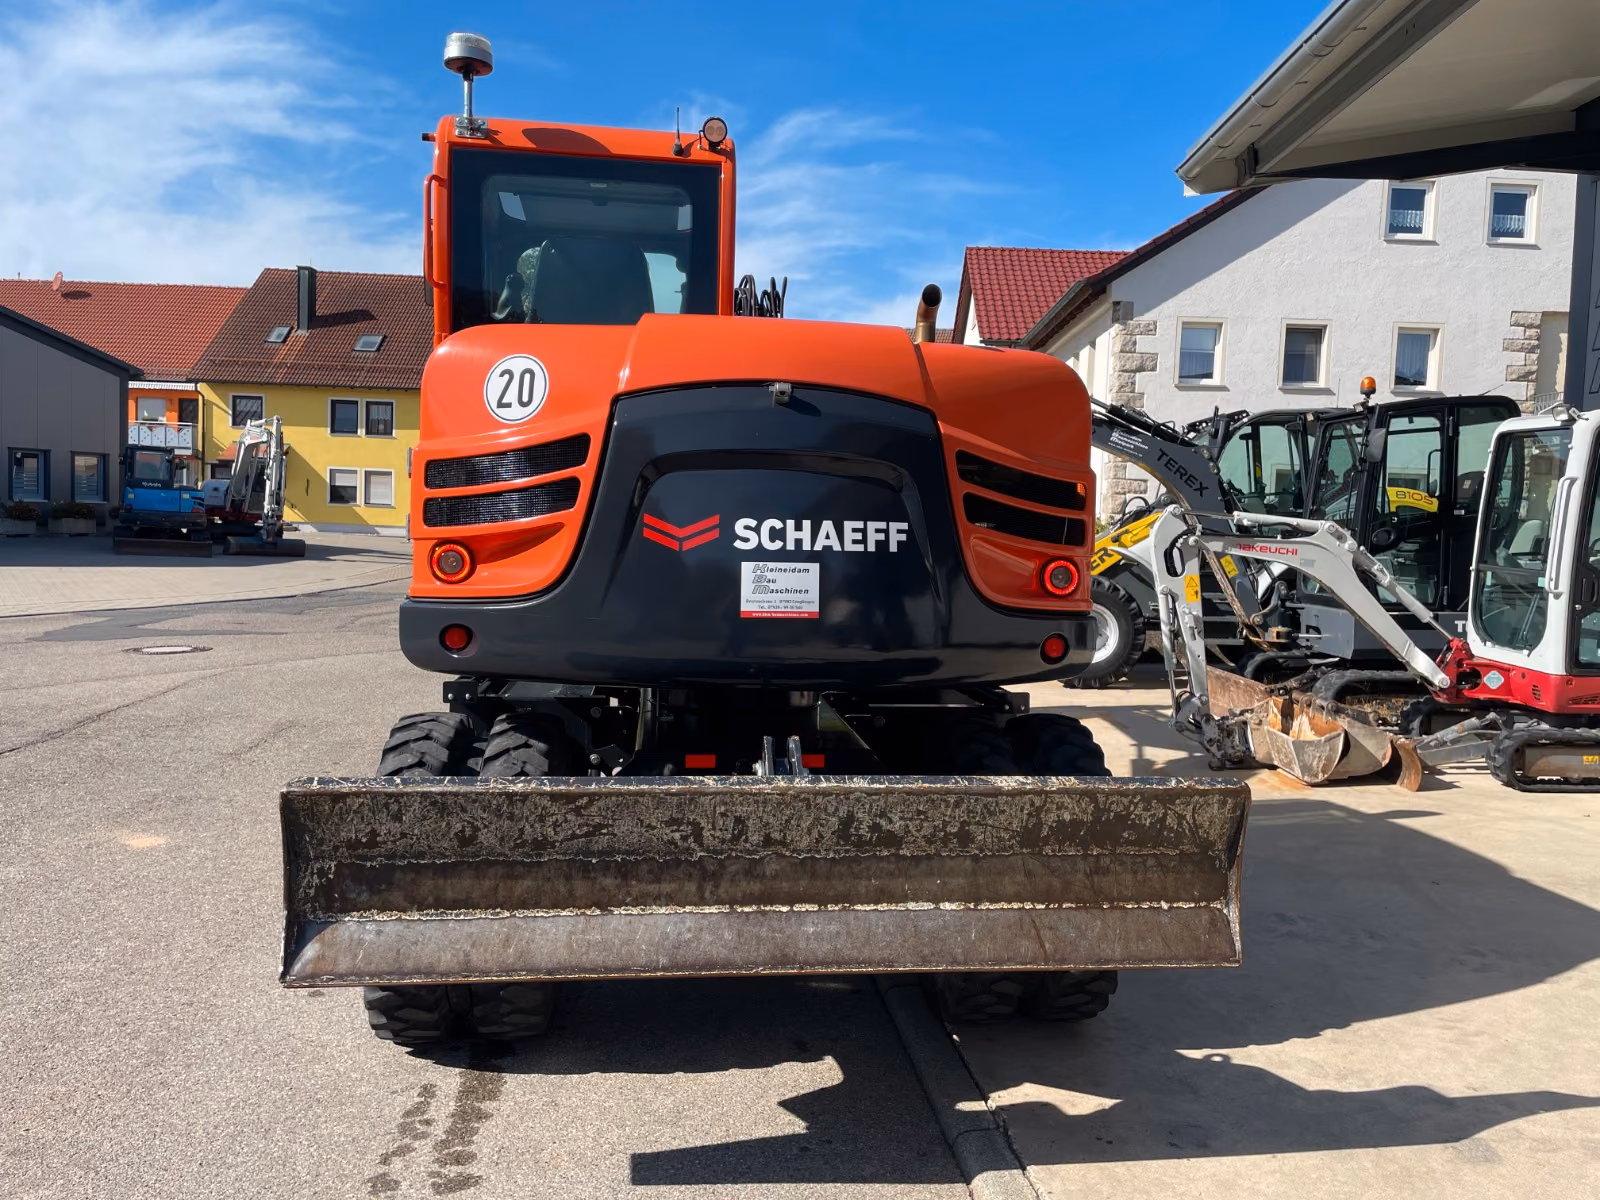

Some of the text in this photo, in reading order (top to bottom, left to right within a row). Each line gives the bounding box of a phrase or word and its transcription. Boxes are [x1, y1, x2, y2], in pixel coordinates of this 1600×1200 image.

[496, 367, 536, 409] 20
[1157, 447, 1210, 498] TEREX
[732, 517, 909, 552] SCHAEFF
[752, 563, 810, 574] Kleineidam
[752, 574, 777, 584] Bau
[752, 584, 809, 594] Maschinen
